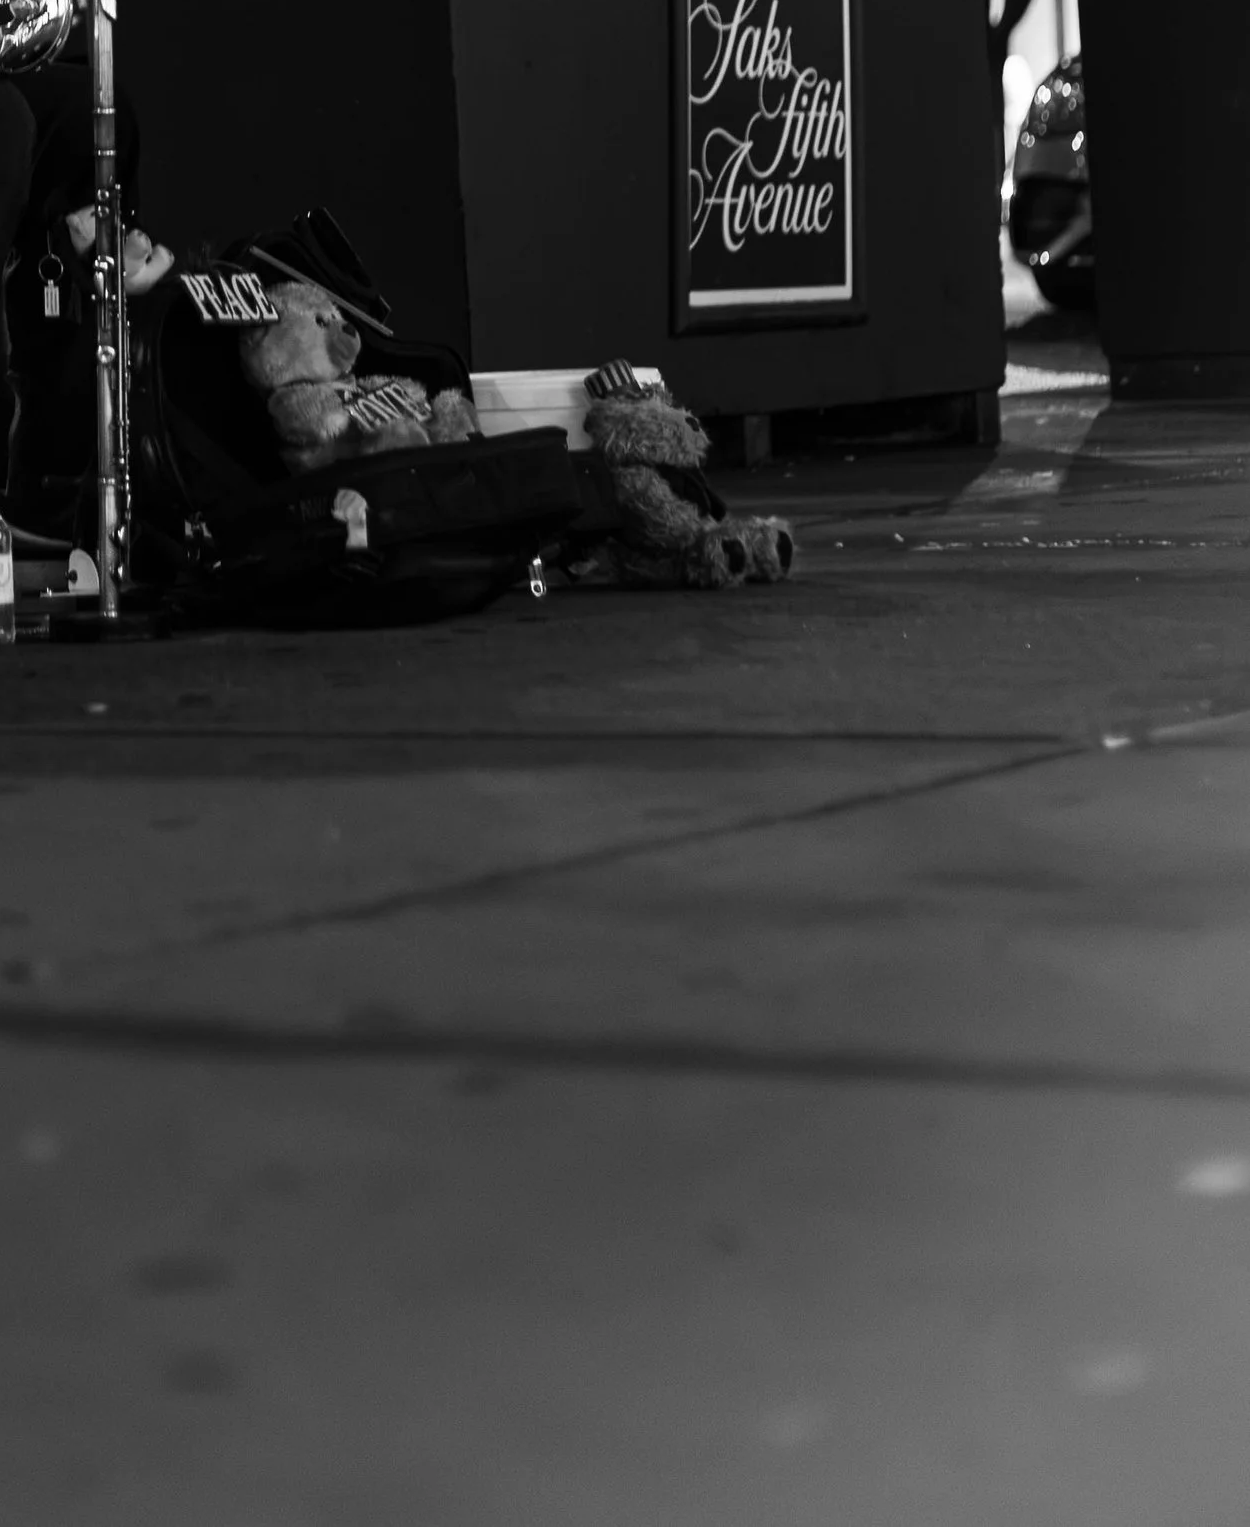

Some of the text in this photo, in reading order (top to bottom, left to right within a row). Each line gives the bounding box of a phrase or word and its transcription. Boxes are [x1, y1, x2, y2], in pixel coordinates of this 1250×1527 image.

[746, 58, 846, 179] Fifth
[689, 127, 834, 253] Avenue
[179, 271, 279, 320] PEACE
